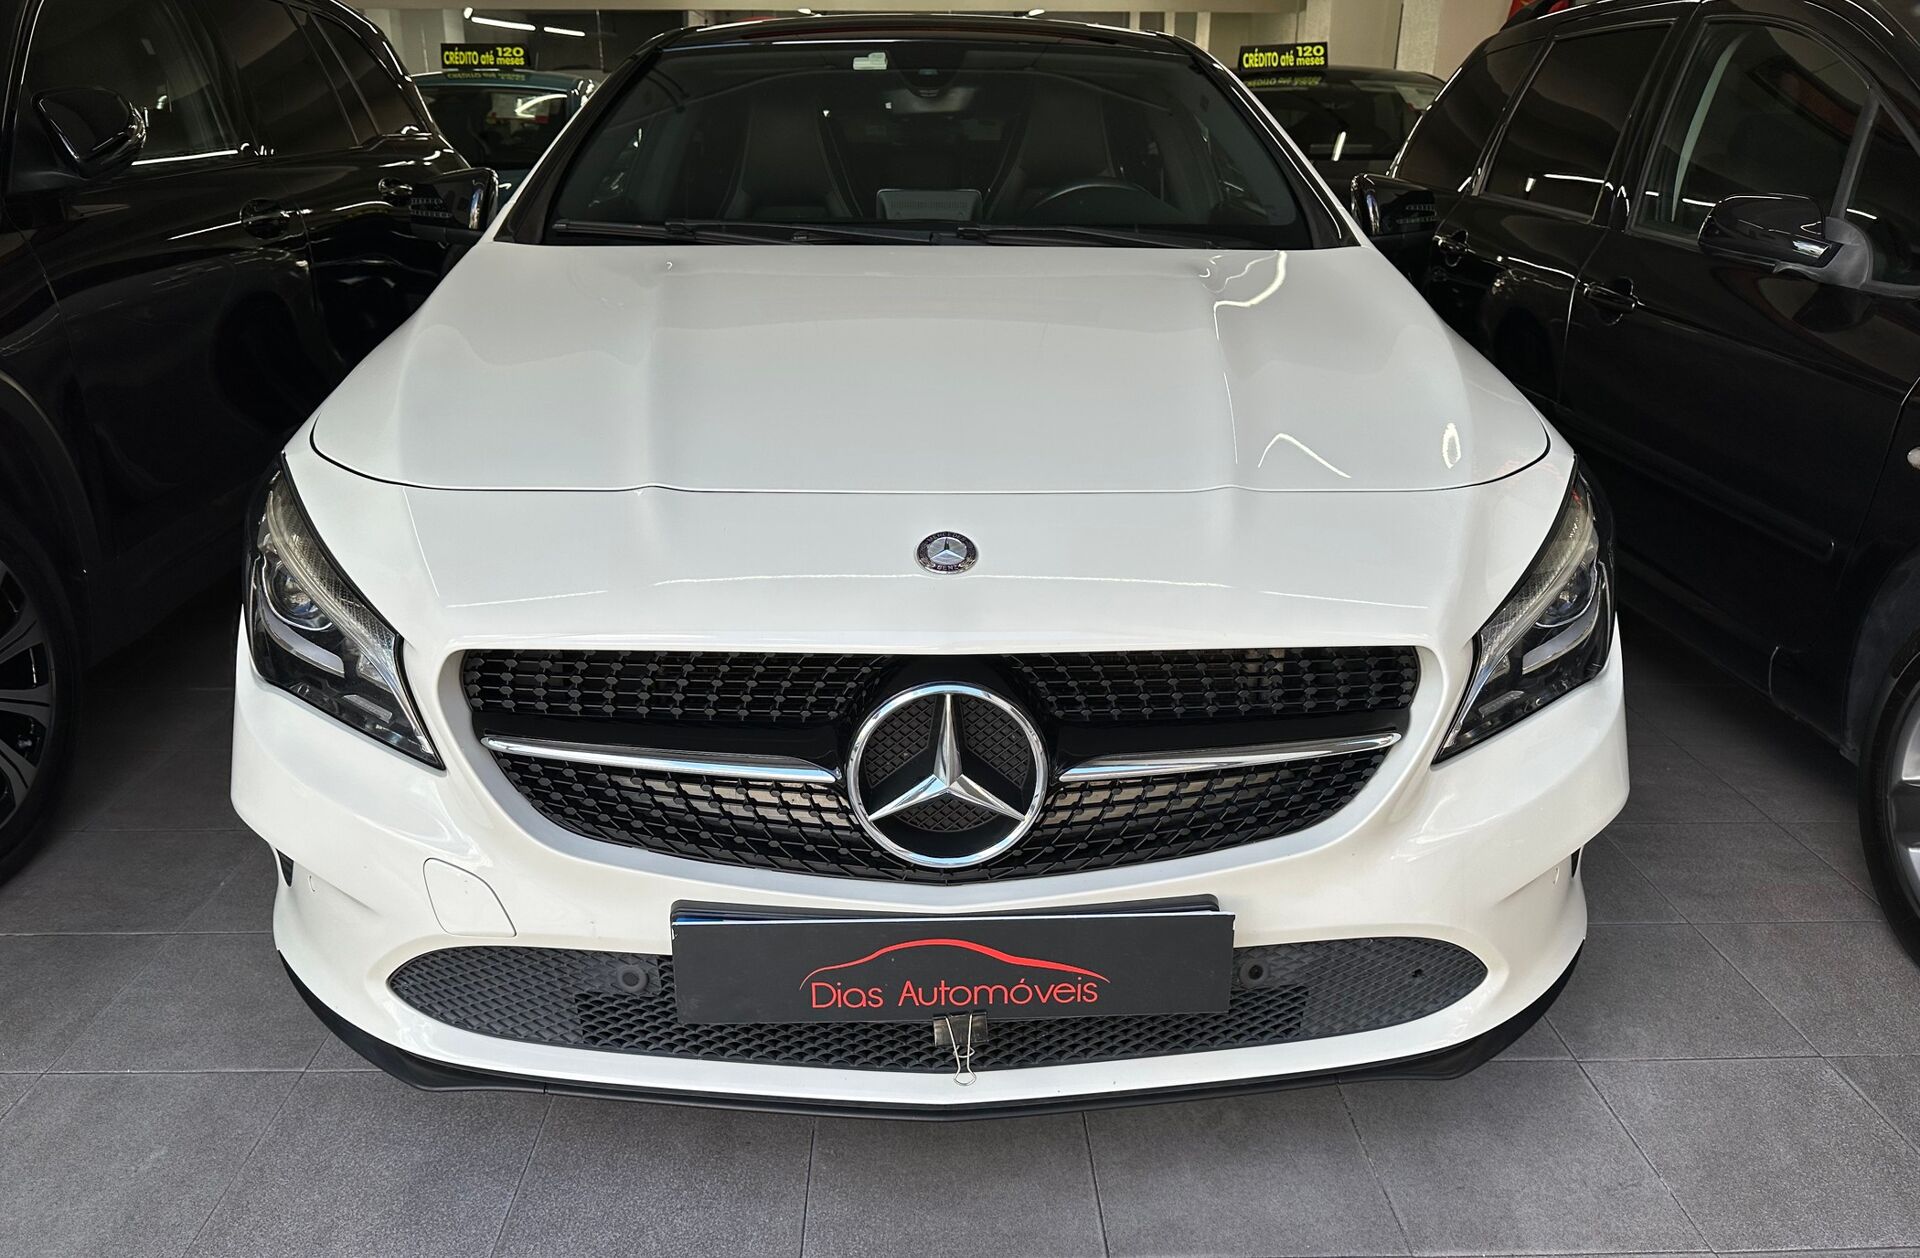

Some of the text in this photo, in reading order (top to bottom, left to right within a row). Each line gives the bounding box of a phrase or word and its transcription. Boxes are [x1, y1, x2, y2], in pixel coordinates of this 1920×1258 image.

[443, 47, 525, 65] CRÉDITO até 120
[496, 57, 525, 65] meses
[1242, 45, 1325, 68] CRÉDITO até 120
[1296, 57, 1325, 66] meses
[811, 977, 1098, 1008] Dias Automóveis
